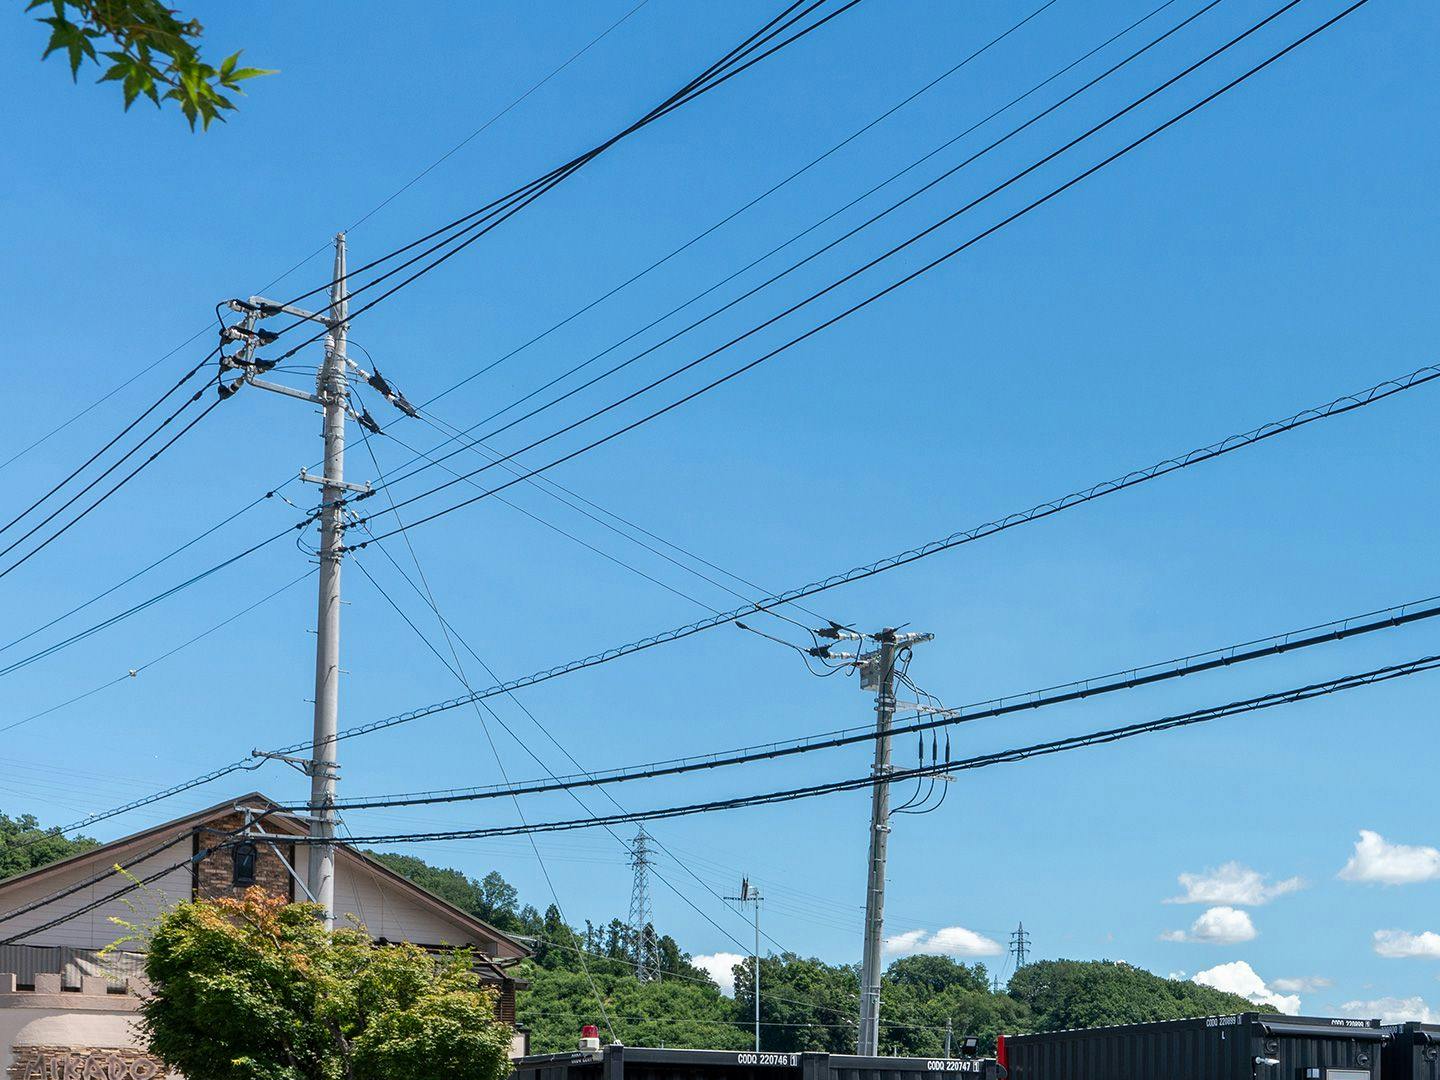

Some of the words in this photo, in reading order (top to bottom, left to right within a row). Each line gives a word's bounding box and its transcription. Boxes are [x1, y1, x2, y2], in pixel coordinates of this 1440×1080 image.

[738, 1053, 758, 1064] CODQ
[760, 1054, 788, 1065] 220746
[927, 1060, 945, 1071] CODQ
[946, 1061, 970, 1071] 220747
